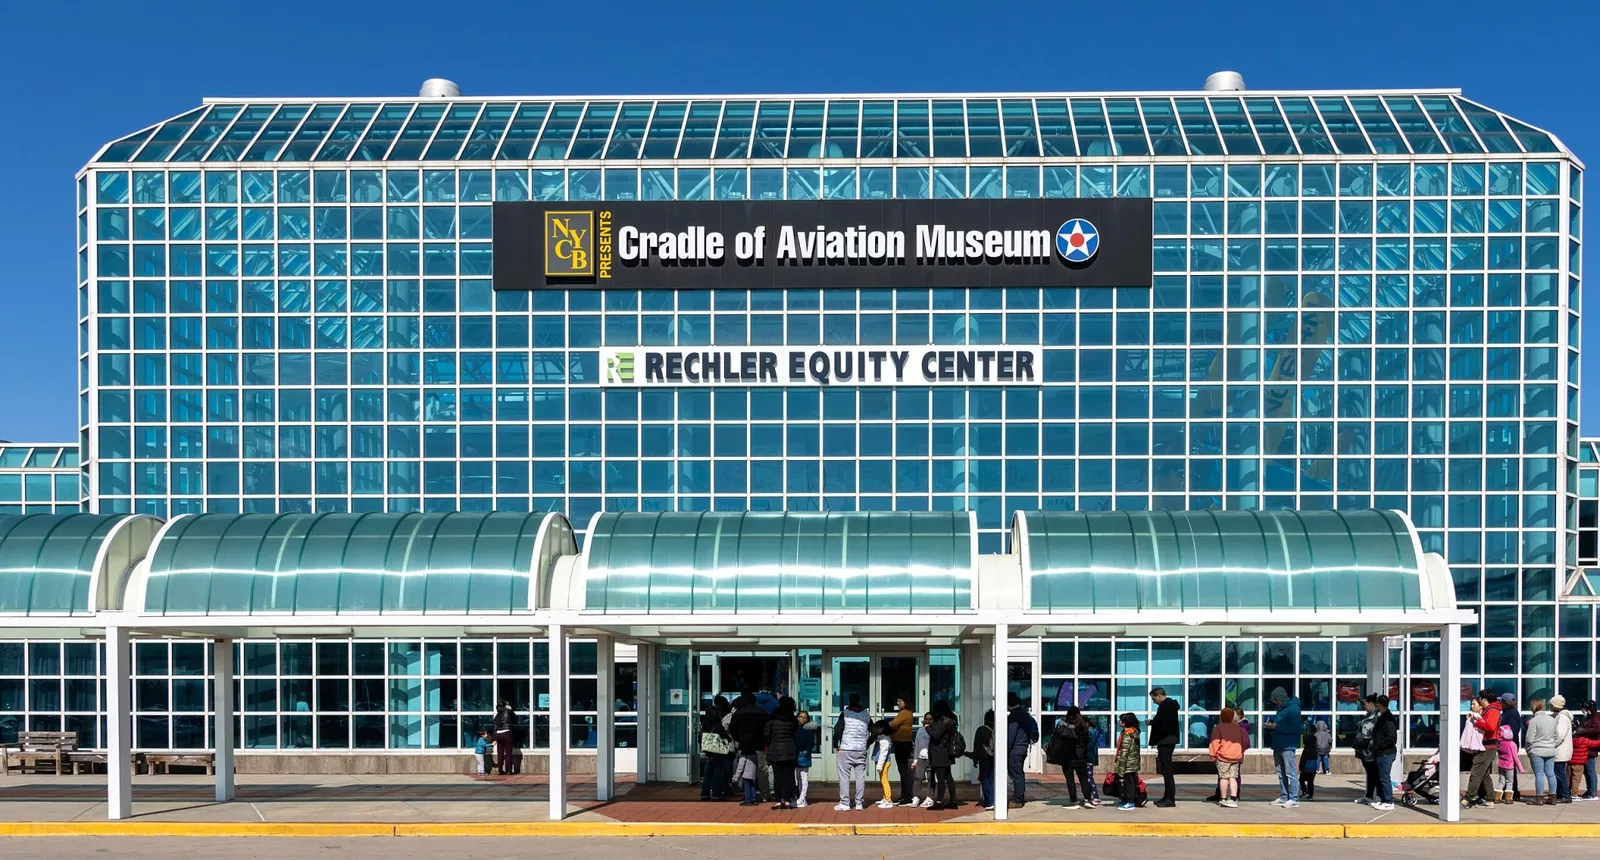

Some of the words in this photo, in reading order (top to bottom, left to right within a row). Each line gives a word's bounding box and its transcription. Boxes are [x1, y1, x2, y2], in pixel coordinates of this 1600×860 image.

[551, 218, 588, 270] NYCB
[599, 210, 612, 279] PRESENTS
[618, 225, 725, 260] Cradle
[735, 225, 766, 260] of
[776, 225, 905, 260] Aviation
[915, 224, 1051, 260] Museum
[645, 351, 779, 382] RECHLER
[788, 350, 909, 384] EQUITY
[921, 350, 1035, 382] CENTER
